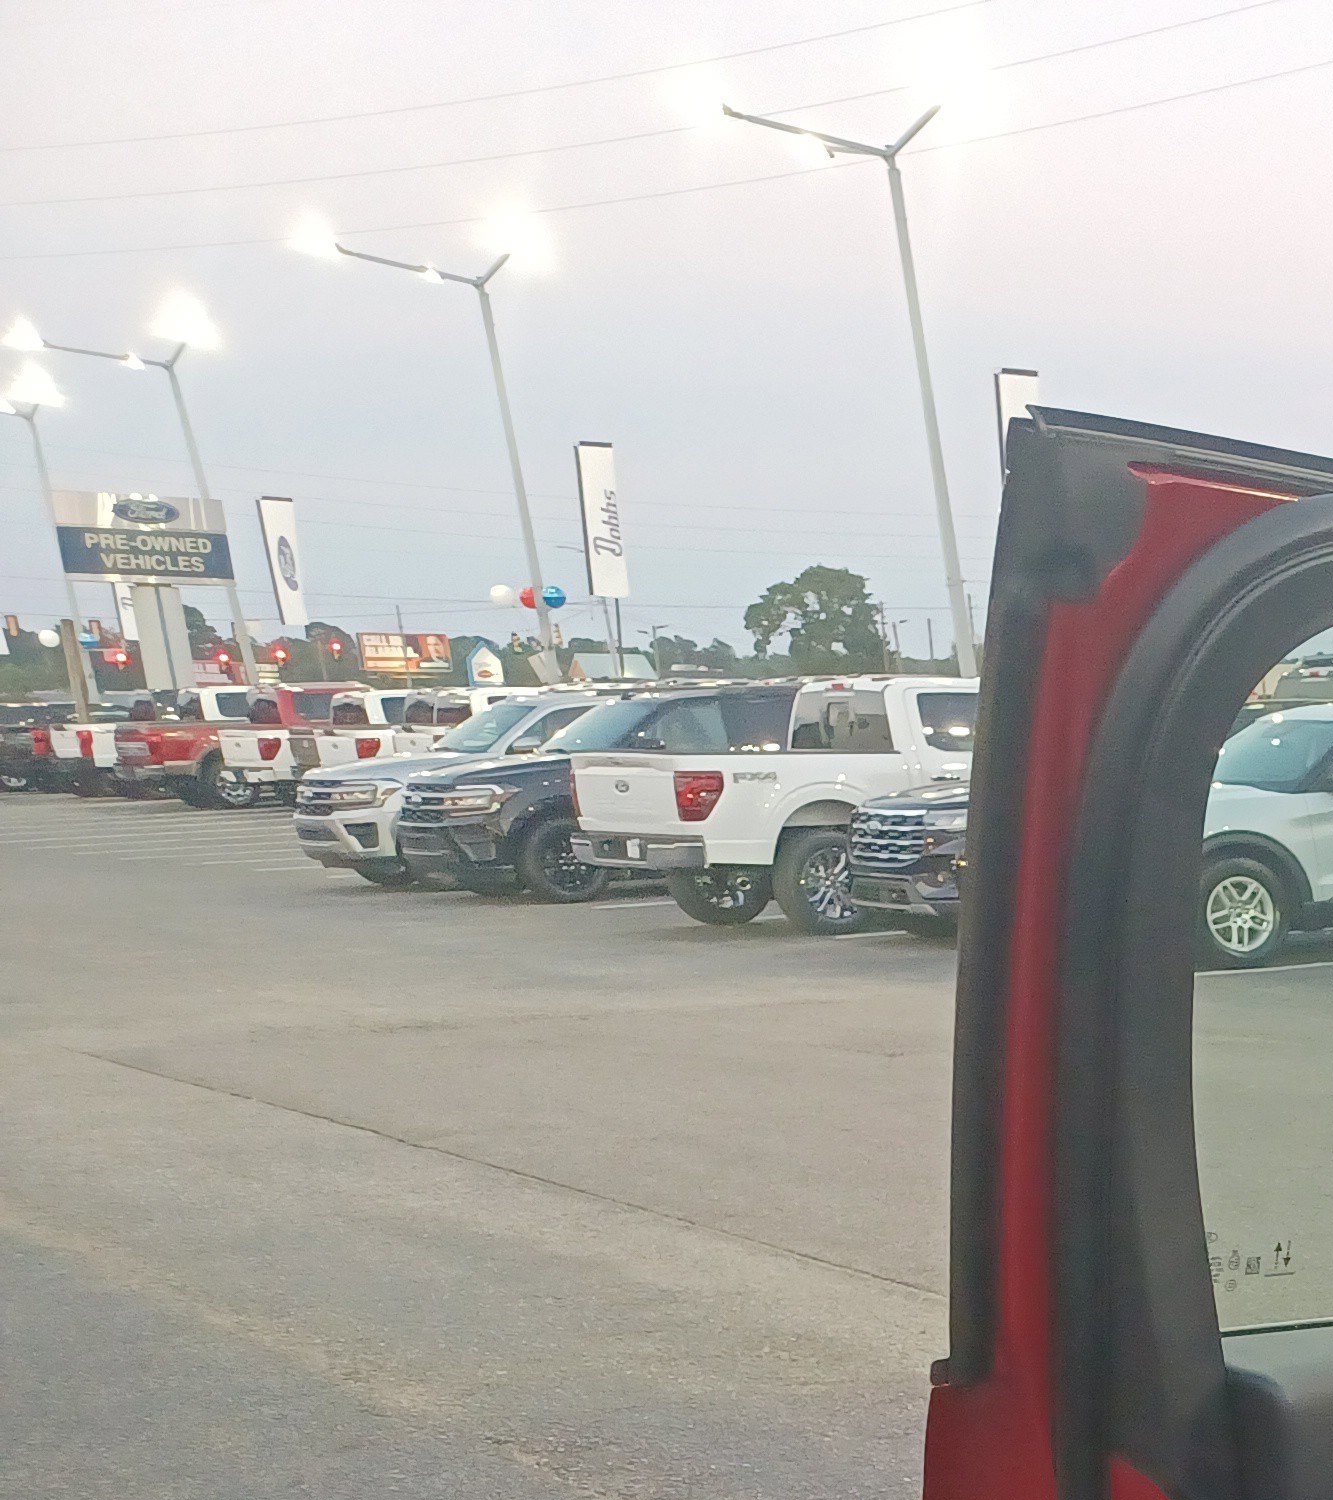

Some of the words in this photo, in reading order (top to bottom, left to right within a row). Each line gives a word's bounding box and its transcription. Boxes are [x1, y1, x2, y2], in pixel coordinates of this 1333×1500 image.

[592, 488, 623, 557] Dobbs
[84, 532, 212, 554] PRE-OWNED
[100, 553, 205, 573] VEHICLES
